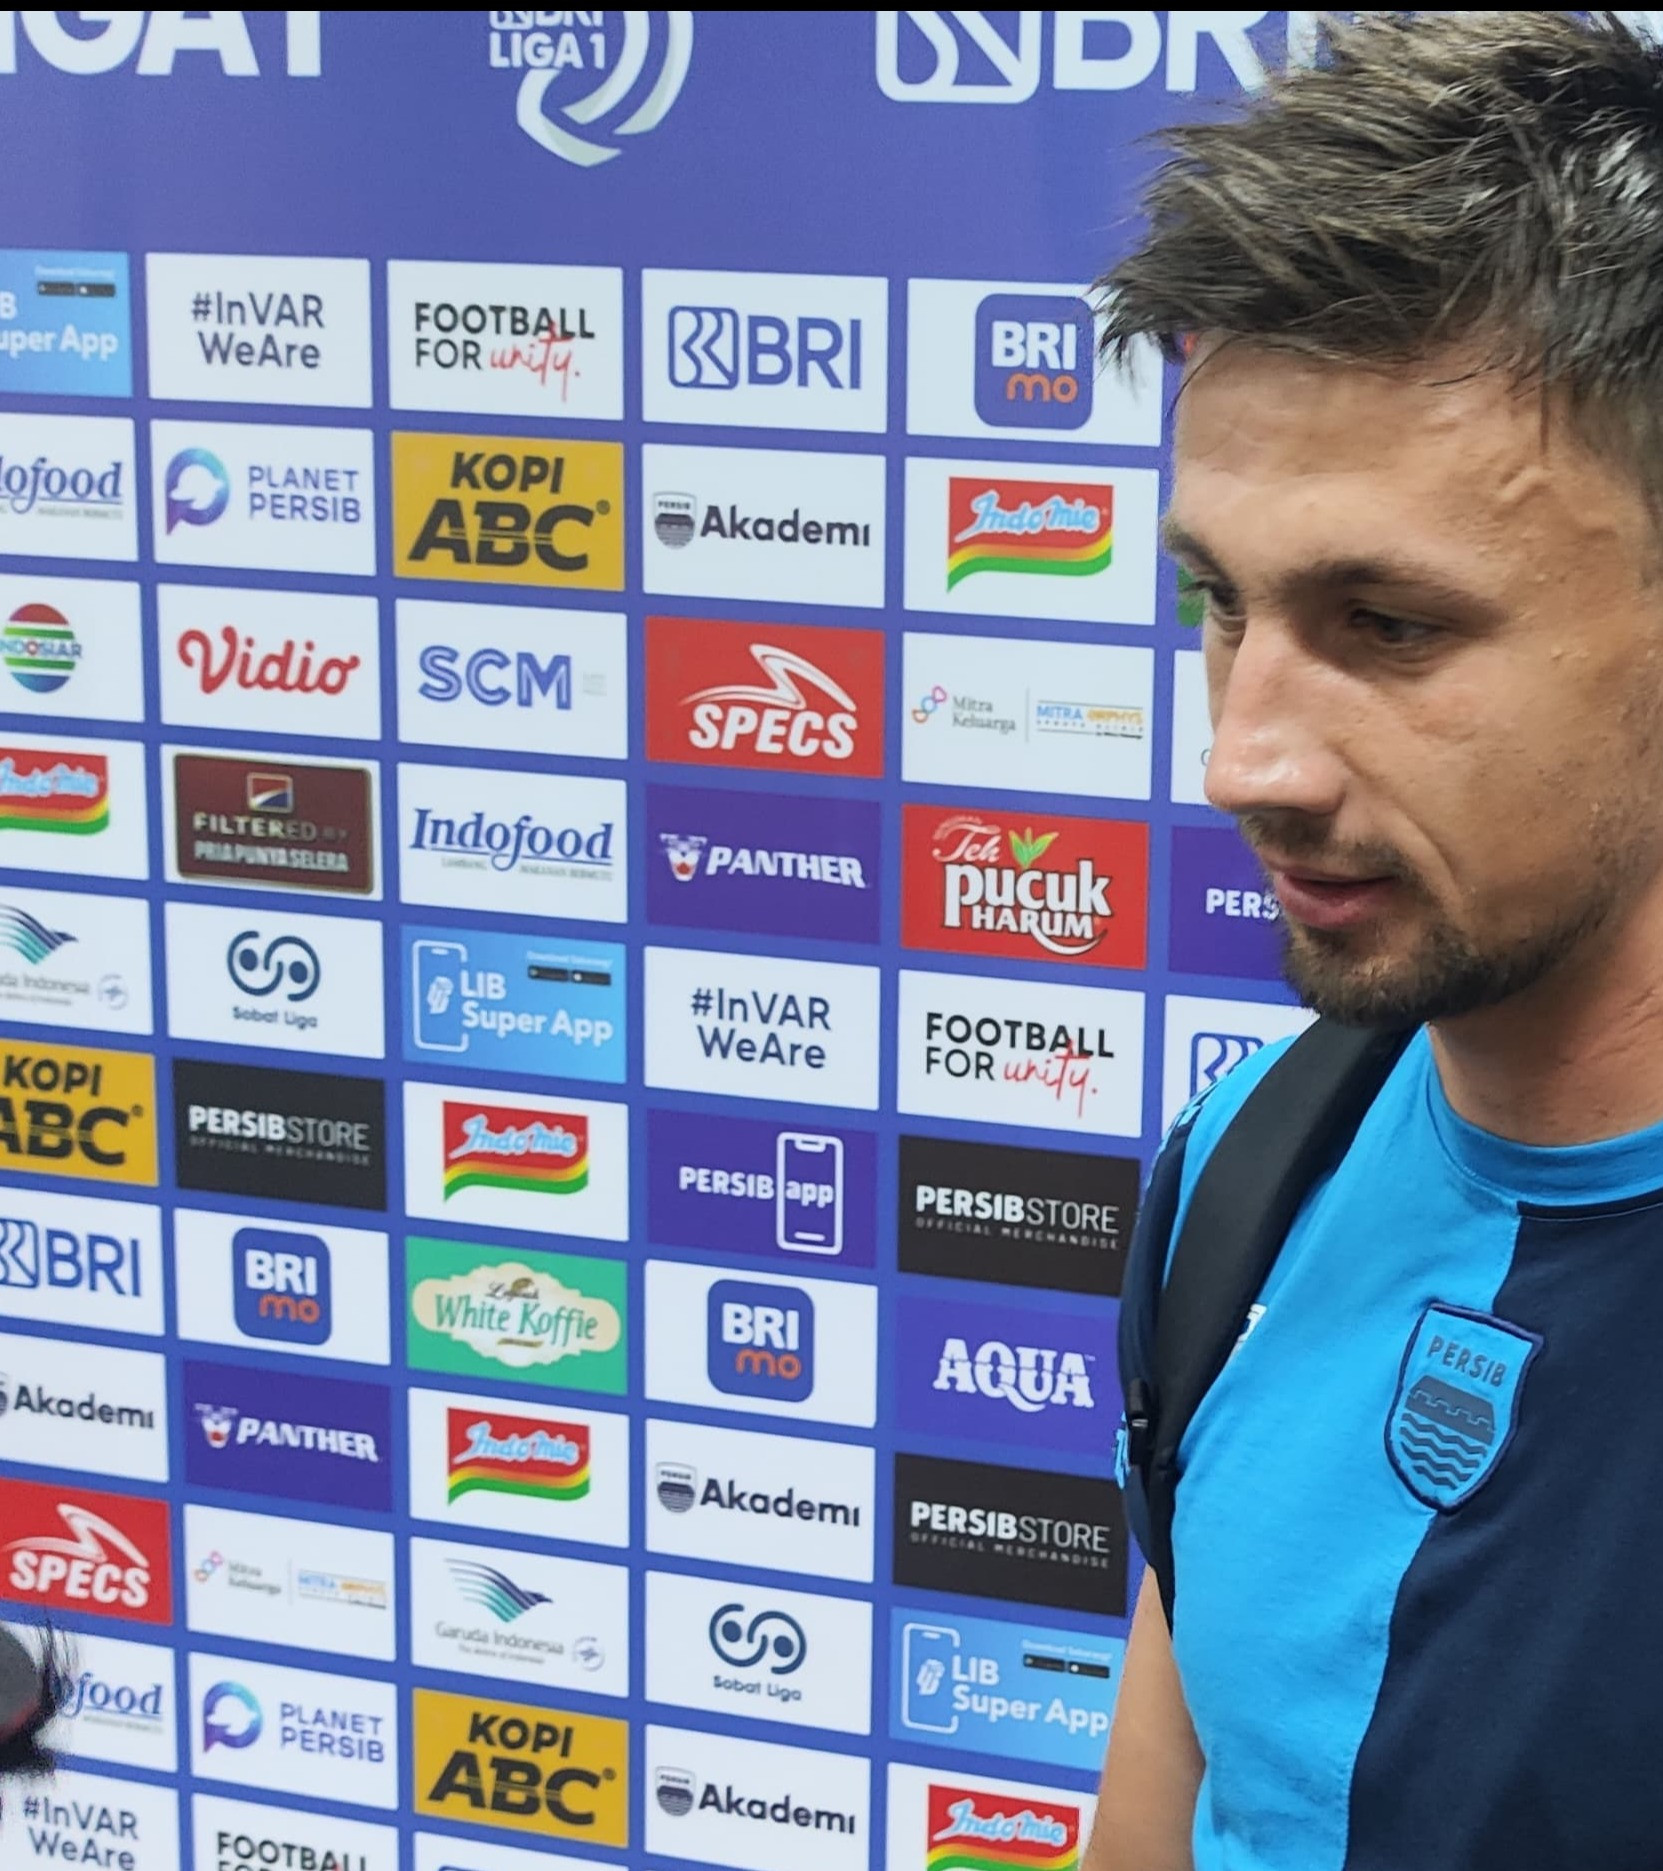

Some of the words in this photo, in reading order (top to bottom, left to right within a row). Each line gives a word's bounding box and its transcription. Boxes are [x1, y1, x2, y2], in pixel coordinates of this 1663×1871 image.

[490, 31, 584, 69] LIGA
[589, 32, 606, 69] 1
[191, 293, 324, 327] #InVAR
[415, 302, 596, 339] FOOTBALL
[60, 322, 119, 362] App
[197, 332, 321, 369] WeAre
[416, 339, 483, 370] FOR
[747, 315, 863, 390] BRI
[991, 320, 1077, 370] BRI
[1006, 373, 1079, 404] mo
[0, 456, 122, 515] ofood
[249, 466, 359, 492] PLANET
[451, 452, 564, 495] KOPI
[249, 494, 361, 523] PERSIB
[177, 625, 360, 695] Vidio
[418, 645, 572, 711] SCM
[953, 697, 993, 713] Mitra
[688, 702, 859, 760] SPECS
[193, 811, 317, 843] FILTERED
[409, 807, 615, 872] Indofood
[932, 822, 1002, 862] Teh
[706, 845, 867, 889] PANTHER
[944, 859, 1113, 928] pucuk
[971, 903, 1104, 950] HARUM
[460, 970, 507, 1000] LIB
[461, 1000, 548, 1038] Super
[552, 1009, 614, 1047] App
[691, 988, 832, 1031] #InVAR
[697, 1025, 827, 1070] WeAre
[926, 1012, 1115, 1058] FOOTBALL
[3, 1055, 103, 1097] KOPI
[926, 1047, 995, 1081] FOR
[679, 1166, 774, 1200] PERSIB
[785, 1180, 834, 1209] app
[46, 1228, 142, 1297] BRI
[245, 1249, 317, 1295] BRI
[258, 1294, 321, 1323] mo
[435, 1293, 512, 1332] White
[518, 1302, 599, 1348] Koffie
[722, 1302, 800, 1352] BRI
[735, 1348, 802, 1380] mo
[933, 1338, 1095, 1413] AQUA
[1427, 1335, 1507, 1388] PERSIB
[236, 1417, 380, 1463] PANTHER
[9, 1549, 151, 1609] SPECS
[952, 1655, 1000, 1685] LIB
[279, 1702, 384, 1736] PLANET
[952, 1685, 1042, 1723] Super
[1044, 1698, 1110, 1737] App
[280, 1727, 385, 1763] PERSIB
[468, 1712, 574, 1758] KOPI
[24, 1797, 139, 1840] #InVAR
[28, 1827, 136, 1871] WeAre
